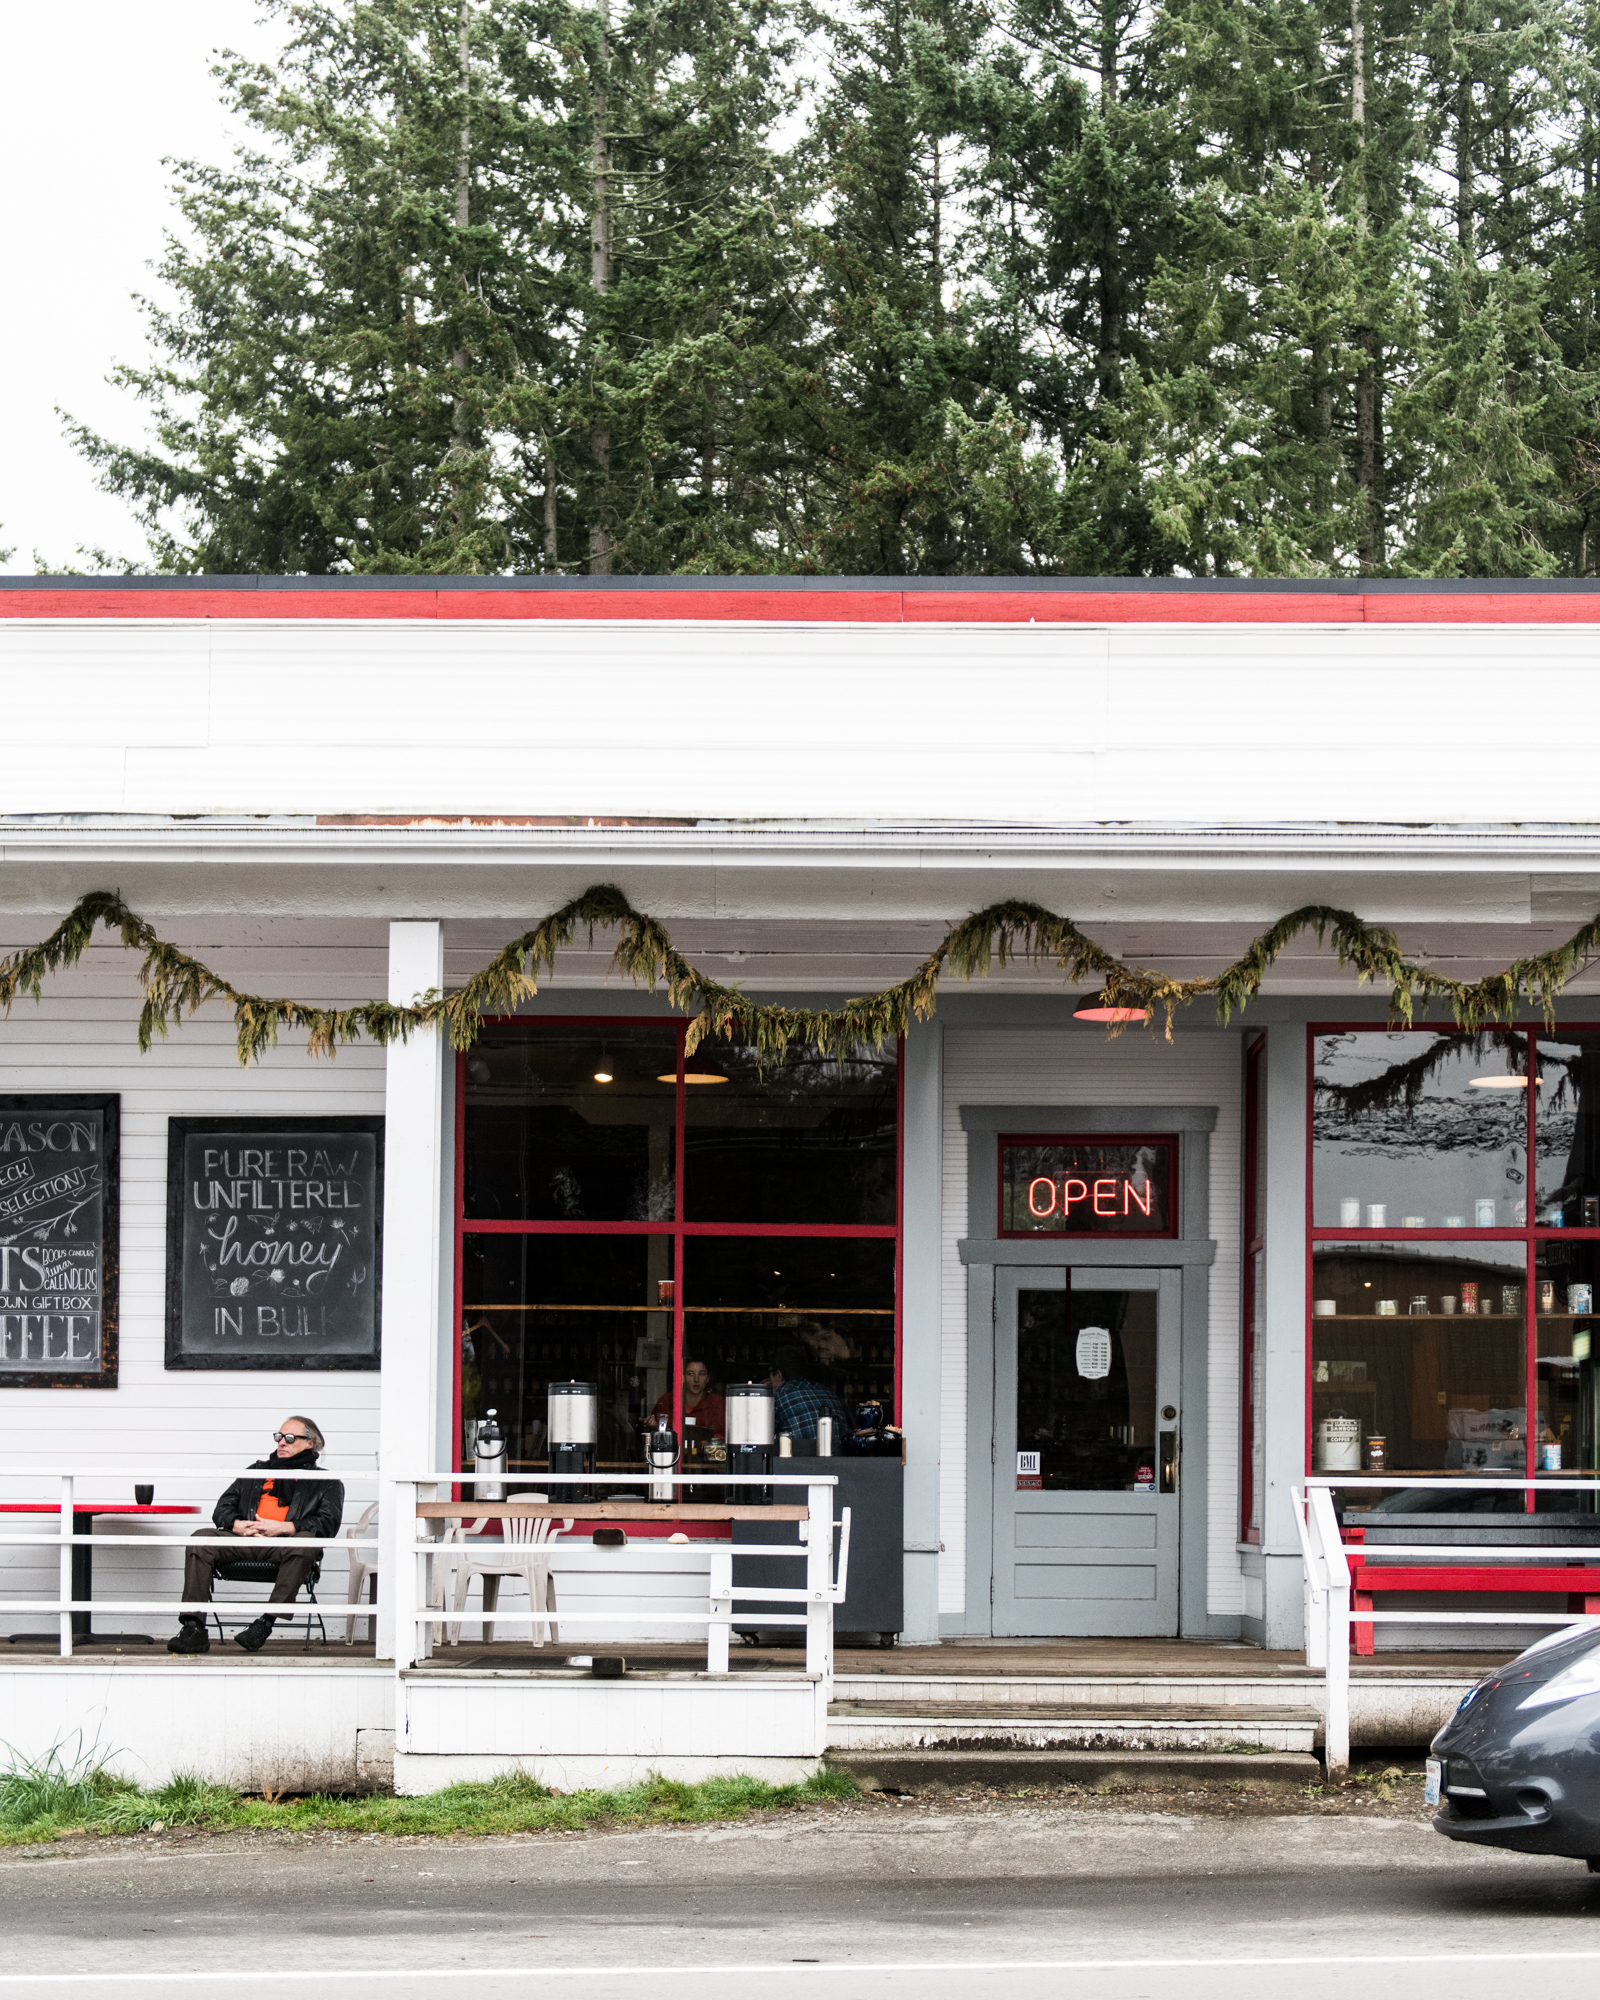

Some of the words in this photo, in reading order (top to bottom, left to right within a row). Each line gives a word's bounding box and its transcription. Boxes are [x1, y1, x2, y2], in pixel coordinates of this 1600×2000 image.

[0, 1122, 97, 1152] ASON
[204, 1149, 282, 1178] PURE
[287, 1149, 359, 1178] RAW
[0, 1171, 80, 1217] SELECTION
[193, 1180, 366, 1210] UNFILTERED
[1029, 1177, 1151, 1216] OPEN
[68, 1249, 95, 1258] CANDLES
[208, 1215, 344, 1296] honey
[43, 1268, 97, 1291] CALENDERS
[214, 1306, 243, 1336] IN
[256, 1305, 338, 1337] BULK
[1020, 1454, 1036, 1469] BMI
